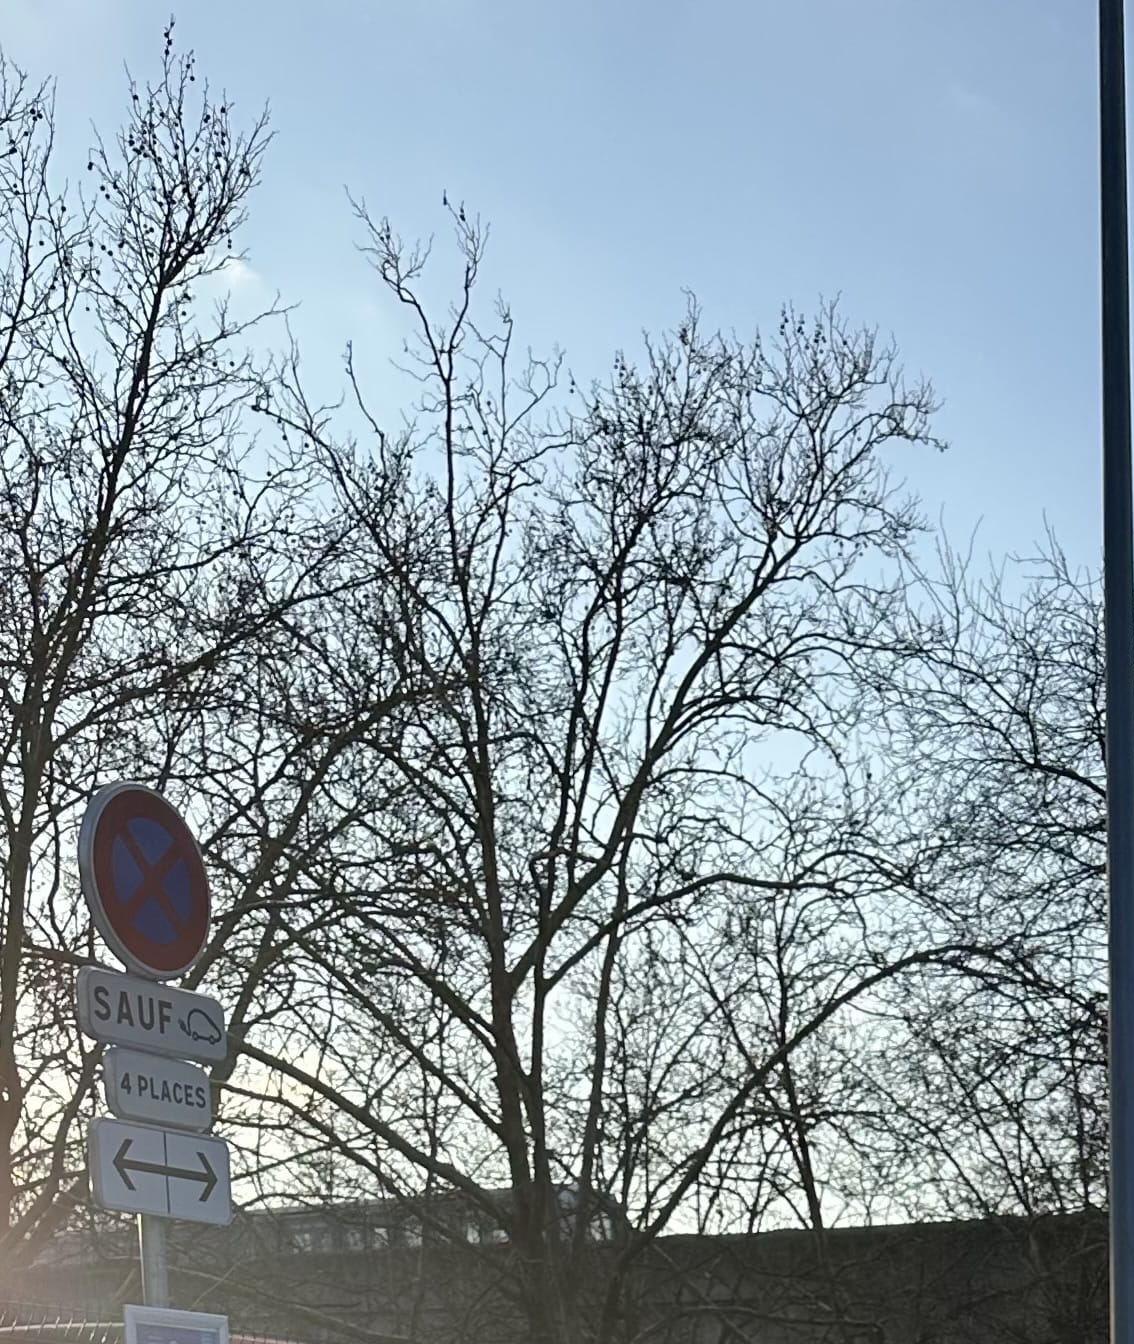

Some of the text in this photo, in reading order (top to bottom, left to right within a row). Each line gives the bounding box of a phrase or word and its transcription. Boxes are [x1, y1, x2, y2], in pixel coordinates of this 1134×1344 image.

[94, 985, 174, 1035] SAUF
[120, 1072, 207, 1109] 4 PLACES
